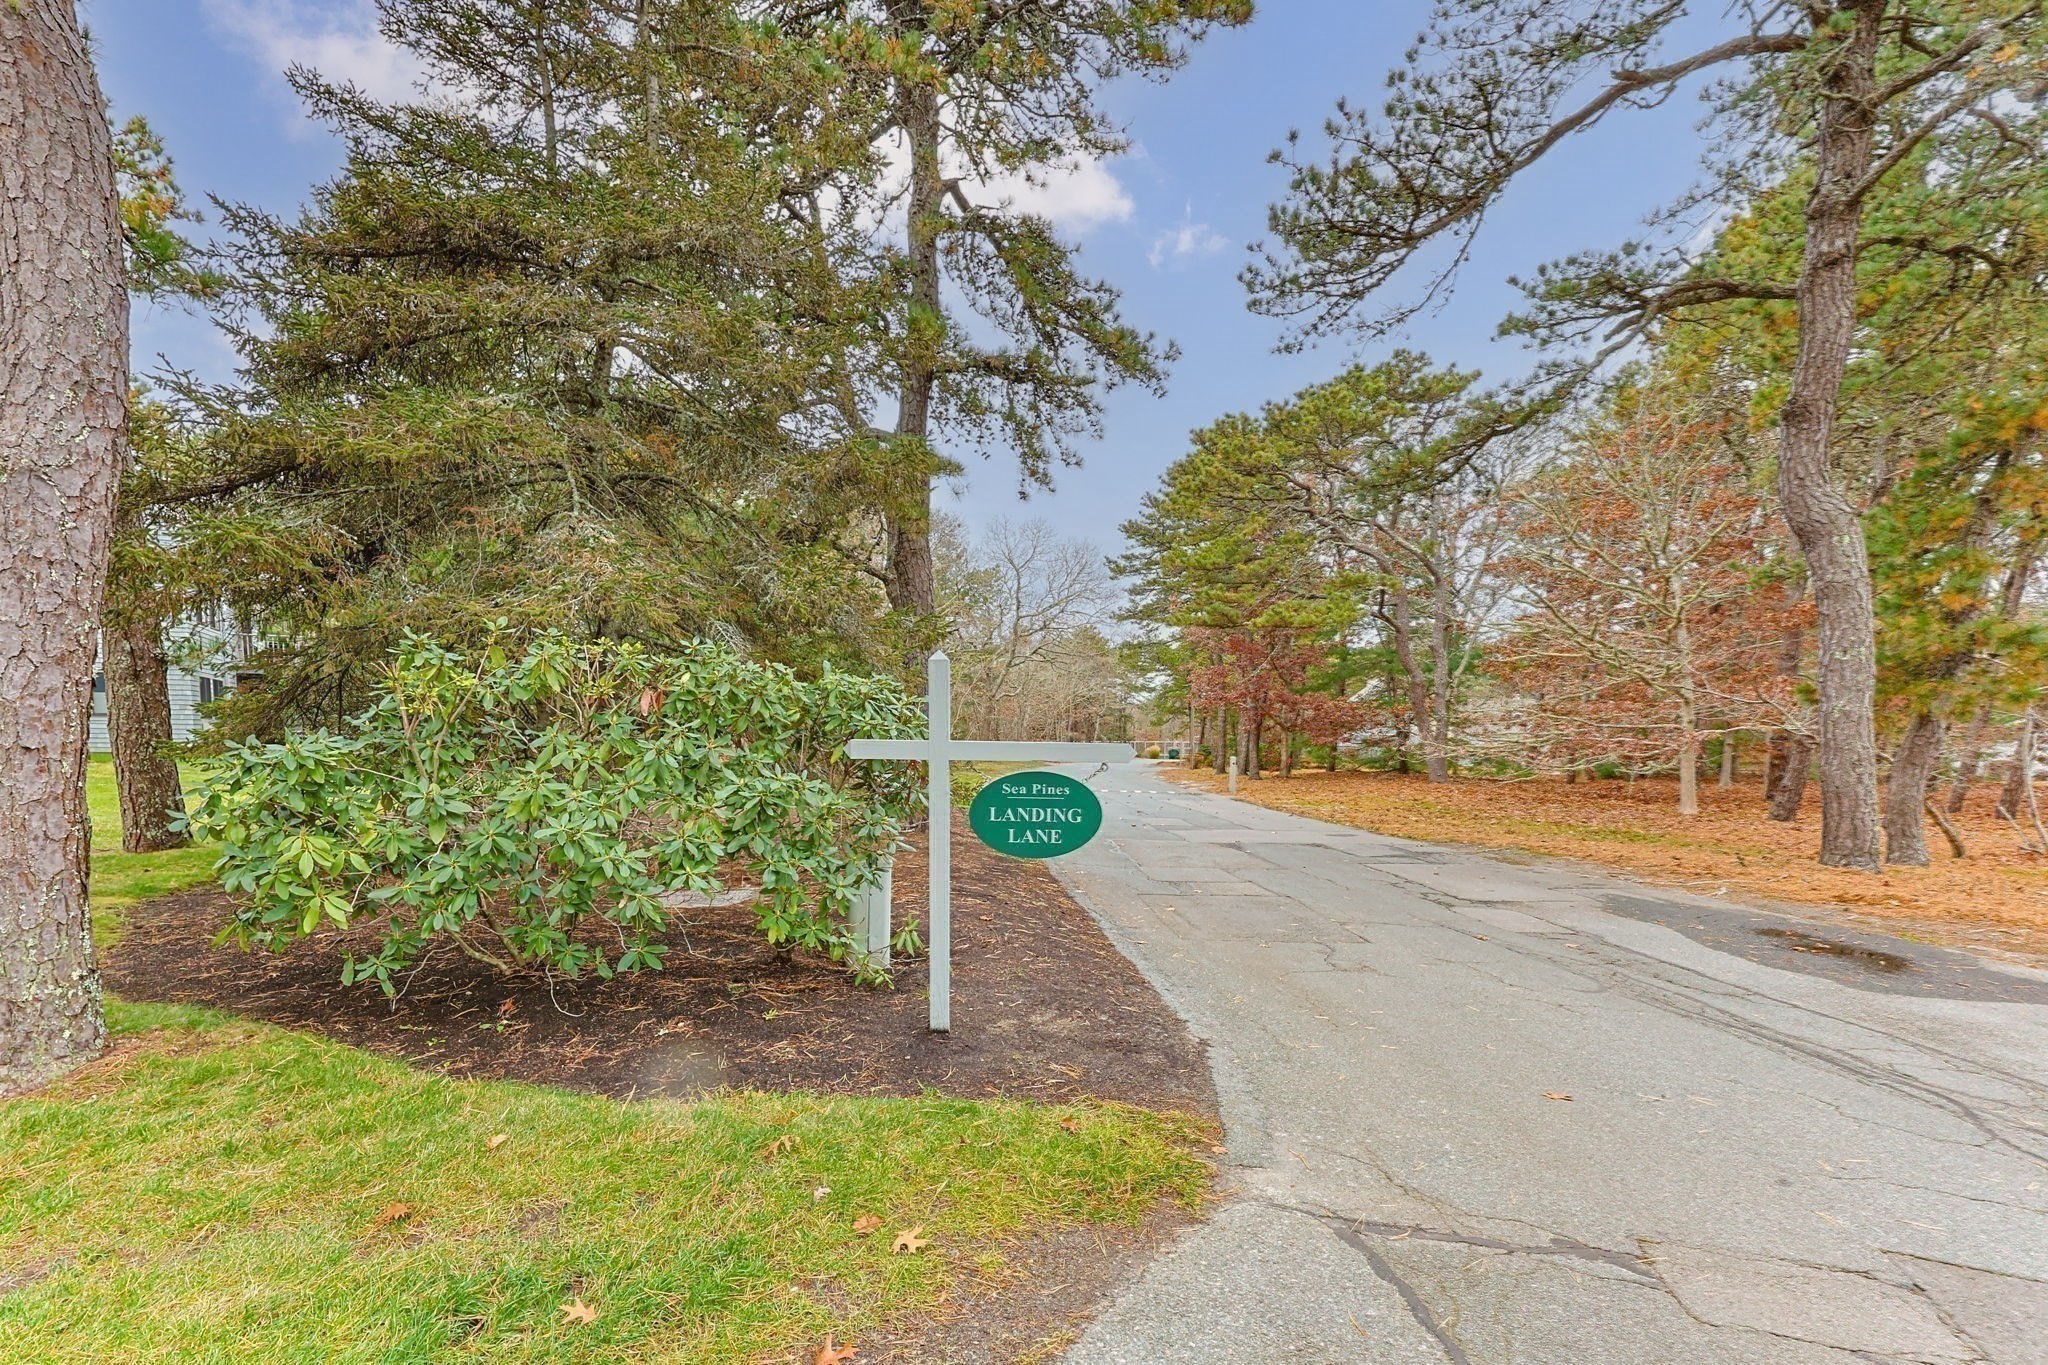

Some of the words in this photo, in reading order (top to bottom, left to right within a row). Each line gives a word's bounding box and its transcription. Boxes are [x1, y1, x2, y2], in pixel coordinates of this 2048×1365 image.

[1001, 783, 1027, 795] Sea
[1032, 783, 1070, 795] Pines
[989, 806, 1082, 823] LANDING
[1008, 828, 1062, 844] LANE
